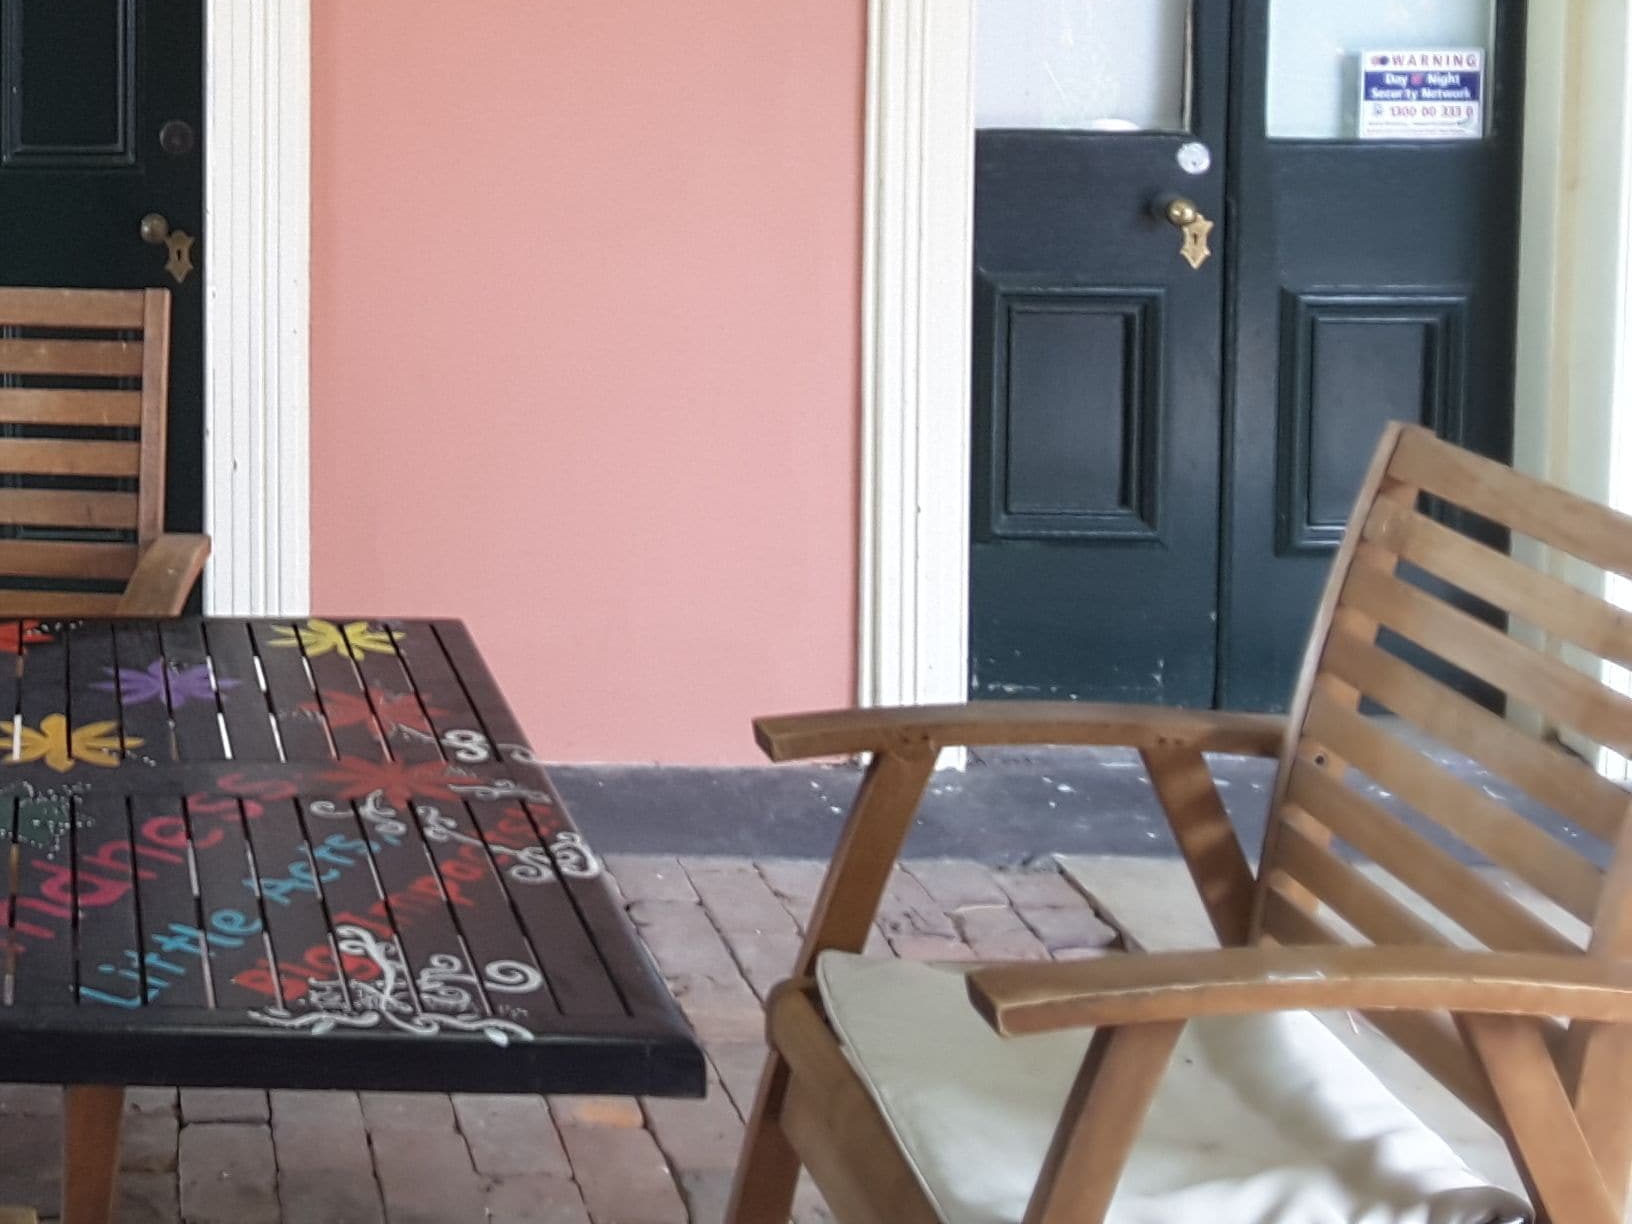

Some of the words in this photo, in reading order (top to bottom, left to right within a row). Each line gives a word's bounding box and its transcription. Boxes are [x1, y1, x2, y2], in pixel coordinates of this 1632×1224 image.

[1391, 53, 1477, 67] WARNING
[1385, 72, 1408, 88] Day
[1426, 71, 1460, 86] Night
[1421, 86, 1471, 99] Network
[77, 907, 262, 1008] Little
